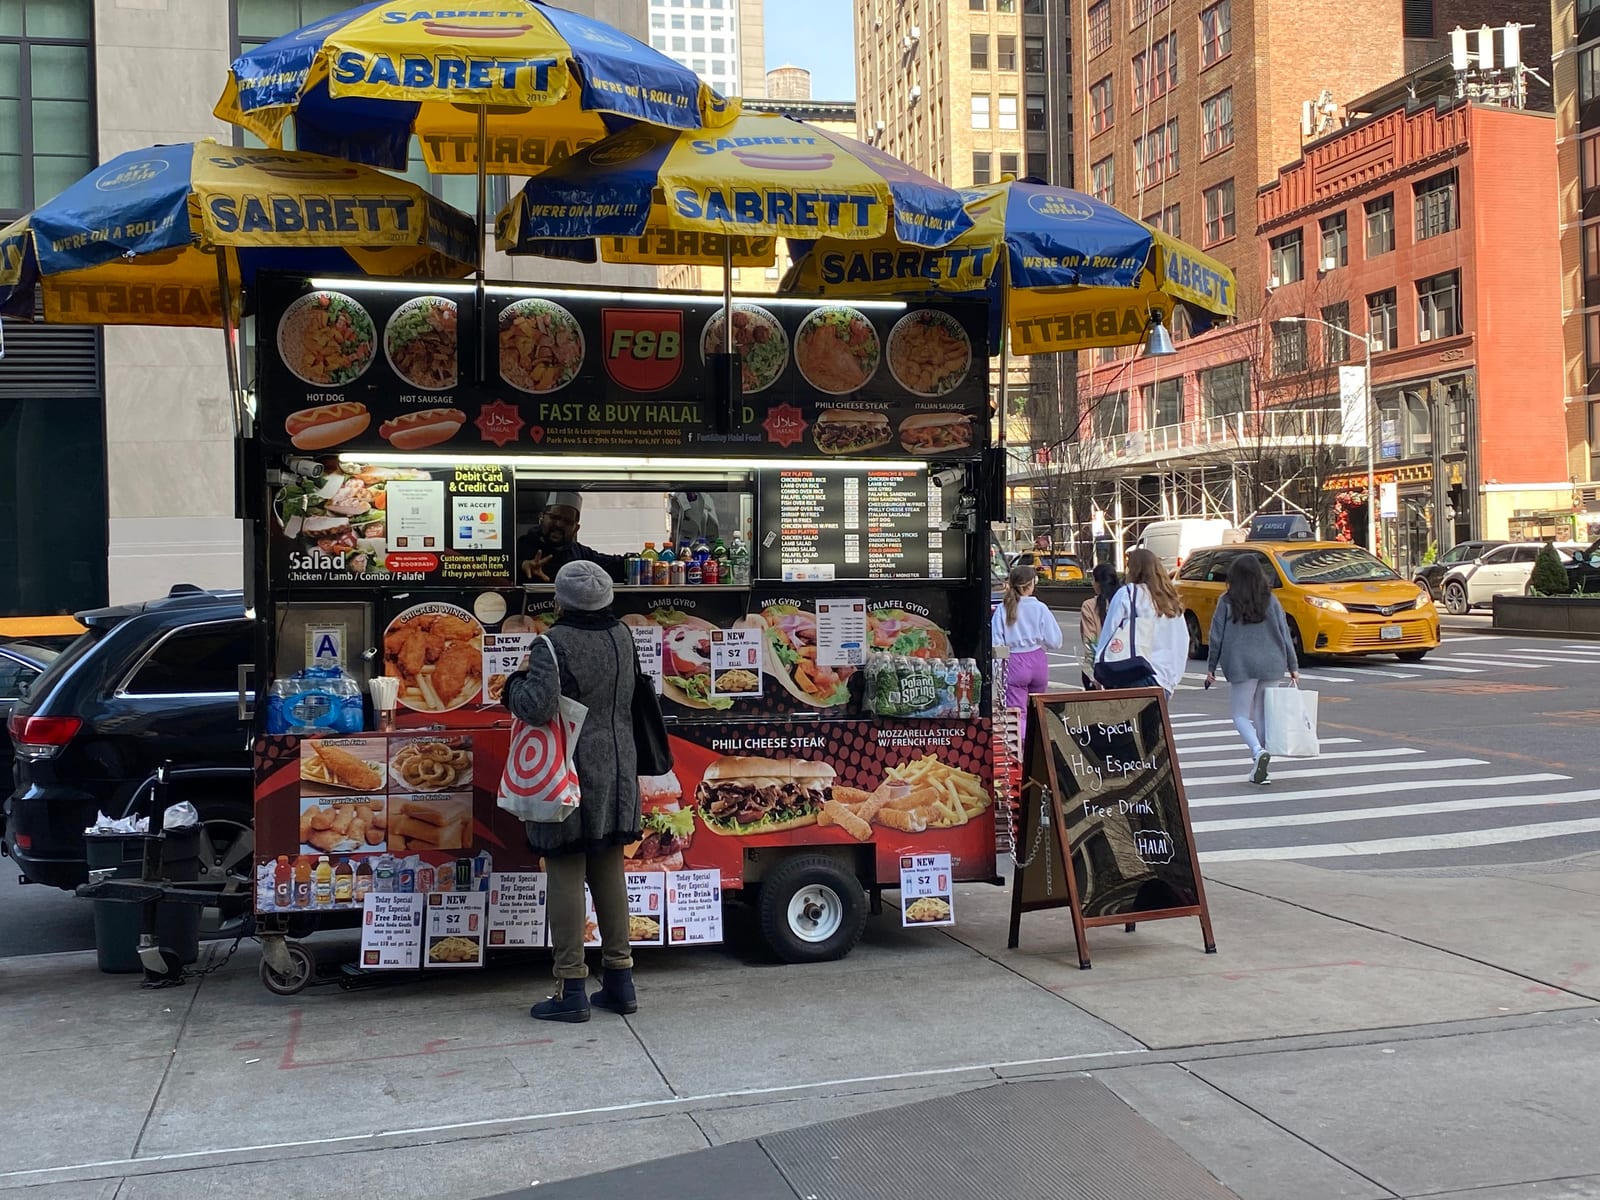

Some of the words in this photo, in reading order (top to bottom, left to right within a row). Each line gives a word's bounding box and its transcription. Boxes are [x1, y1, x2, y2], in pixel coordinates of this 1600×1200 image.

[381, 10, 526, 24] SABRETT
[332, 51, 558, 92] SABRETT
[526, 93, 548, 102] 2019
[592, 77, 624, 95] WE'RE
[625, 84, 640, 97] ON
[642, 89, 649, 99] A
[650, 90, 673, 106] ROLL
[675, 96, 689, 109] !!!
[691, 136, 816, 155] SABRETT
[531, 204, 567, 218] WE'RE
[569, 205, 584, 217] ON
[595, 205, 620, 218] ROLL
[624, 204, 638, 216] !!!
[674, 187, 877, 227] SABRETT
[207, 194, 416, 233] SABRETT
[53, 232, 87, 252] WE'RE
[91, 230, 109, 242] ON
[113, 229, 122, 239] A
[127, 221, 158, 239] ROLL
[161, 215, 175, 230] !!!
[821, 247, 993, 285] SABRETT
[1023, 256, 1057, 269] WE'RE
[1062, 255, 1080, 268] ON
[1081, 255, 1090, 266] A
[1092, 256, 1118, 268] ROLL
[1121, 258, 1135, 269] !!!
[610, 330, 680, 360] F&B
[307, 394, 325, 402] HOT
[326, 394, 345, 403] DOG
[400, 395, 417, 404] HOT
[417, 395, 454, 405] SAUSAGE
[836, 402, 864, 410] CHEESE
[915, 402, 937, 410] ITALIAN
[539, 403, 583, 421] FAST
[587, 404, 600, 422] &
[605, 405, 640, 422] BUY
[645, 406, 702, 423] HALAL
[487, 412, 514, 426] حلال
[772, 415, 799, 428] حلال
[612, 428, 623, 436] Ave
[547, 437, 561, 445] Park
[563, 437, 576, 445] Ave
[611, 437, 618, 445] St
[618, 438, 631, 446] New
[661, 438, 681, 446] 10016
[455, 472, 480, 482] Debit
[482, 472, 503, 482] Card
[449, 482, 457, 492] &
[458, 482, 486, 492] Credit
[487, 482, 509, 493] Card
[289, 552, 346, 570] Salad
[488, 556, 500, 564] pay
[329, 571, 353, 581] Lamb
[360, 571, 390, 581] Combo
[397, 571, 426, 581] Falafel
[448, 571, 462, 579] they
[463, 572, 476, 580] pay
[477, 570, 492, 578] with
[493, 570, 510, 578] cards
[648, 598, 671, 609] LAMB
[673, 598, 697, 609] GYRO
[761, 599, 776, 608] MIX
[777, 598, 802, 608] GYRO
[867, 600, 904, 613] FALAFEL
[905, 601, 930, 617] GYRO
[400, 605, 440, 625] CHICKEN
[441, 605, 472, 623] WINGS
[636, 628, 654, 636] Special
[727, 632, 745, 641] NEW
[316, 634, 338, 658] A
[497, 636, 521, 645] NEW
[728, 649, 741, 657] $7
[502, 656, 519, 667] $7
[900, 674, 934, 690] Poland
[901, 684, 936, 704] Spring
[877, 728, 935, 738] MOZZARELLA
[937, 727, 966, 737] STICKS
[1062, 716, 1091, 746] Tody
[1098, 719, 1140, 742] Special
[712, 739, 742, 750] PHILI
[744, 738, 788, 749] CHEESE
[790, 737, 825, 748] STEAK
[877, 739, 891, 747] W/
[893, 738, 928, 746] FRENCH
[930, 737, 951, 746] FRIES
[1072, 754, 1103, 791] Hoy
[1106, 755, 1157, 778] Especial
[1083, 799, 1112, 818] Free
[1119, 799, 1154, 815] Drink
[917, 857, 935, 867] NEW
[500, 875, 516, 883] Today
[518, 874, 538, 883] Special
[628, 875, 647, 884] NEW
[676, 874, 691, 882] Today
[692, 873, 711, 881] Special
[918, 876, 931, 885] $7
[277, 883, 287, 896] G
[299, 884, 308, 895] G
[678, 891, 692, 899] Free
[693, 890, 711, 898] Drink
[375, 896, 391, 904] Today
[393, 896, 413, 904] Special
[446, 896, 467, 904] NEW
[628, 895, 641, 903] $7
[388, 905, 411, 913] Especial
[446, 915, 460, 923] $7
